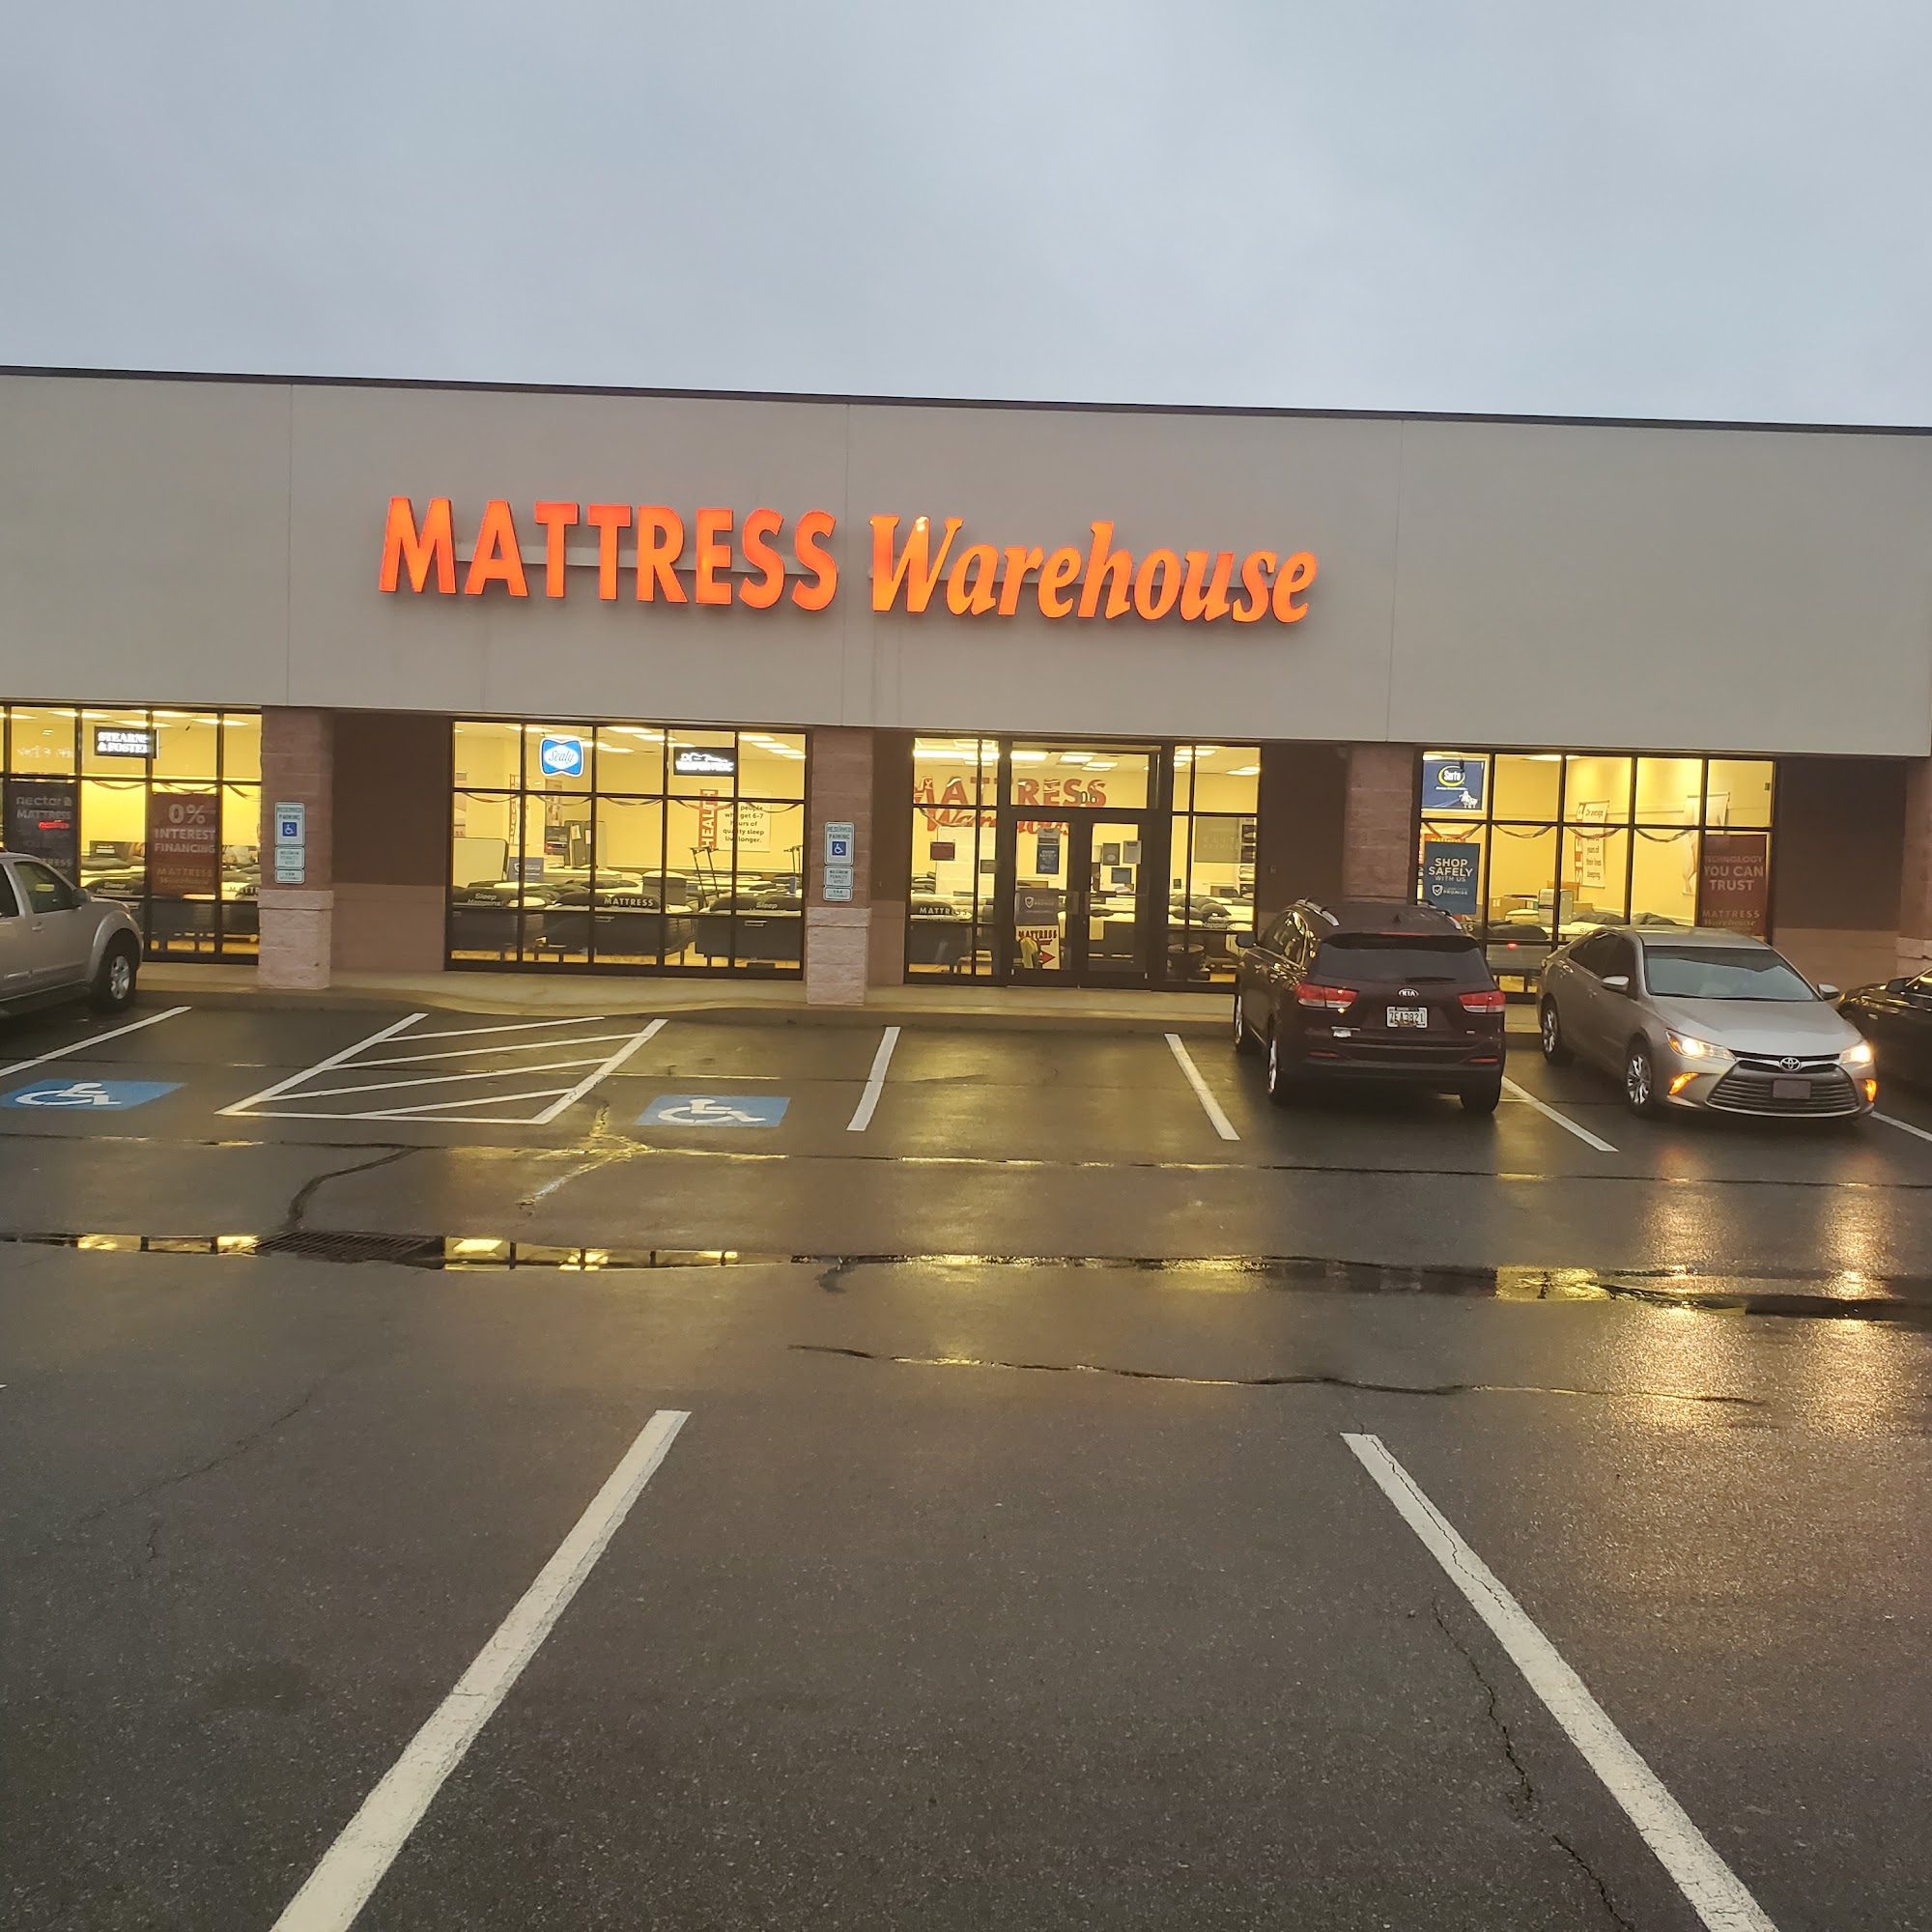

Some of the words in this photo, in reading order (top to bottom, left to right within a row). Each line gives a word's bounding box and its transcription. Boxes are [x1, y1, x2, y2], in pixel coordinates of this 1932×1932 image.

[379, 496, 838, 611] MATTRESS
[869, 515, 1319, 624] Warehouse
[548, 750, 575, 764] Sealy
[913, 777, 1107, 808] MATRESS
[15, 796, 61, 806] nectar
[168, 803, 206, 824] 0%
[155, 828, 215, 839] INTEREST
[155, 842, 215, 854] FINANCING
[1435, 857, 1468, 867] SHOP
[1428, 866, 1473, 877] SAFELY
[1703, 866, 1729, 876] YOU
[1732, 866, 1764, 876] CAN
[1709, 879, 1755, 891] TRUST
[604, 897, 654, 906] MATTRESS
